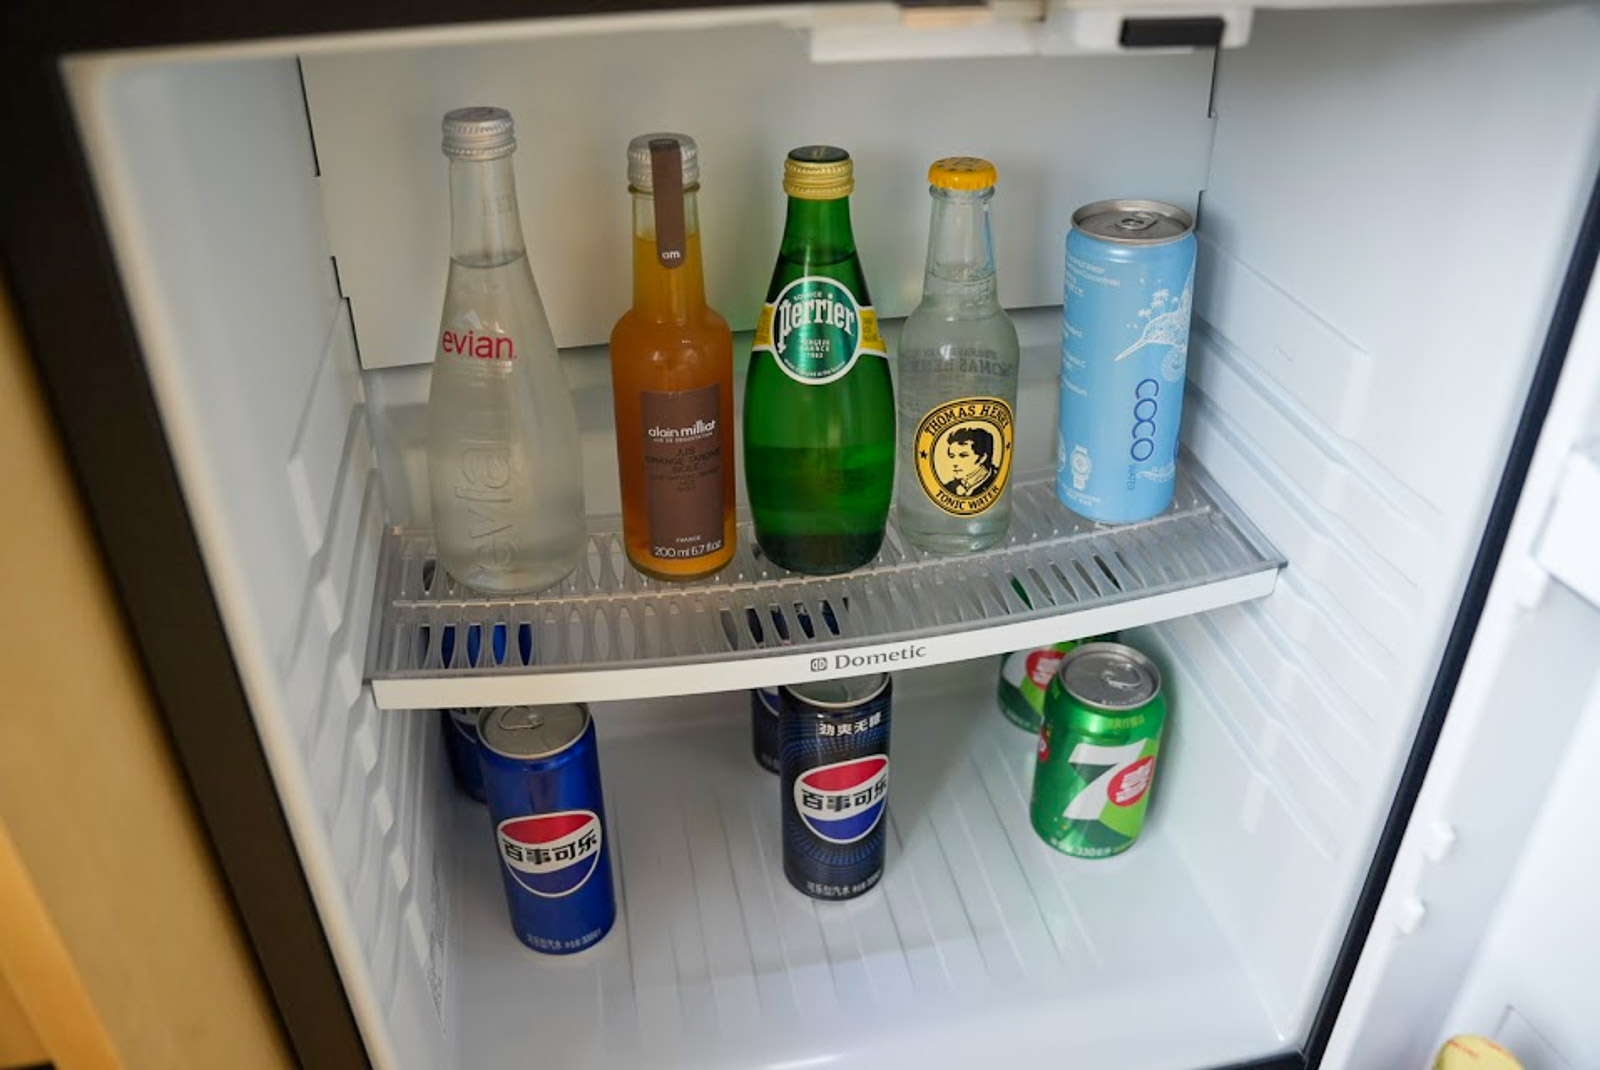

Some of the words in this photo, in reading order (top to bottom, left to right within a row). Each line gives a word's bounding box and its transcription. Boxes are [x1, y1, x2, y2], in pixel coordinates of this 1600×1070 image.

[661, 250, 681, 260] am
[441, 330, 514, 360] evian
[648, 425, 680, 437] alain
[924, 405, 976, 436] THOMAS
[935, 489, 965, 510] TONIC
[654, 546, 676, 557] 200
[834, 644, 927, 670] Dometic
[801, 773, 887, 813] 百事可乐
[502, 828, 598, 865] 百事可乐
